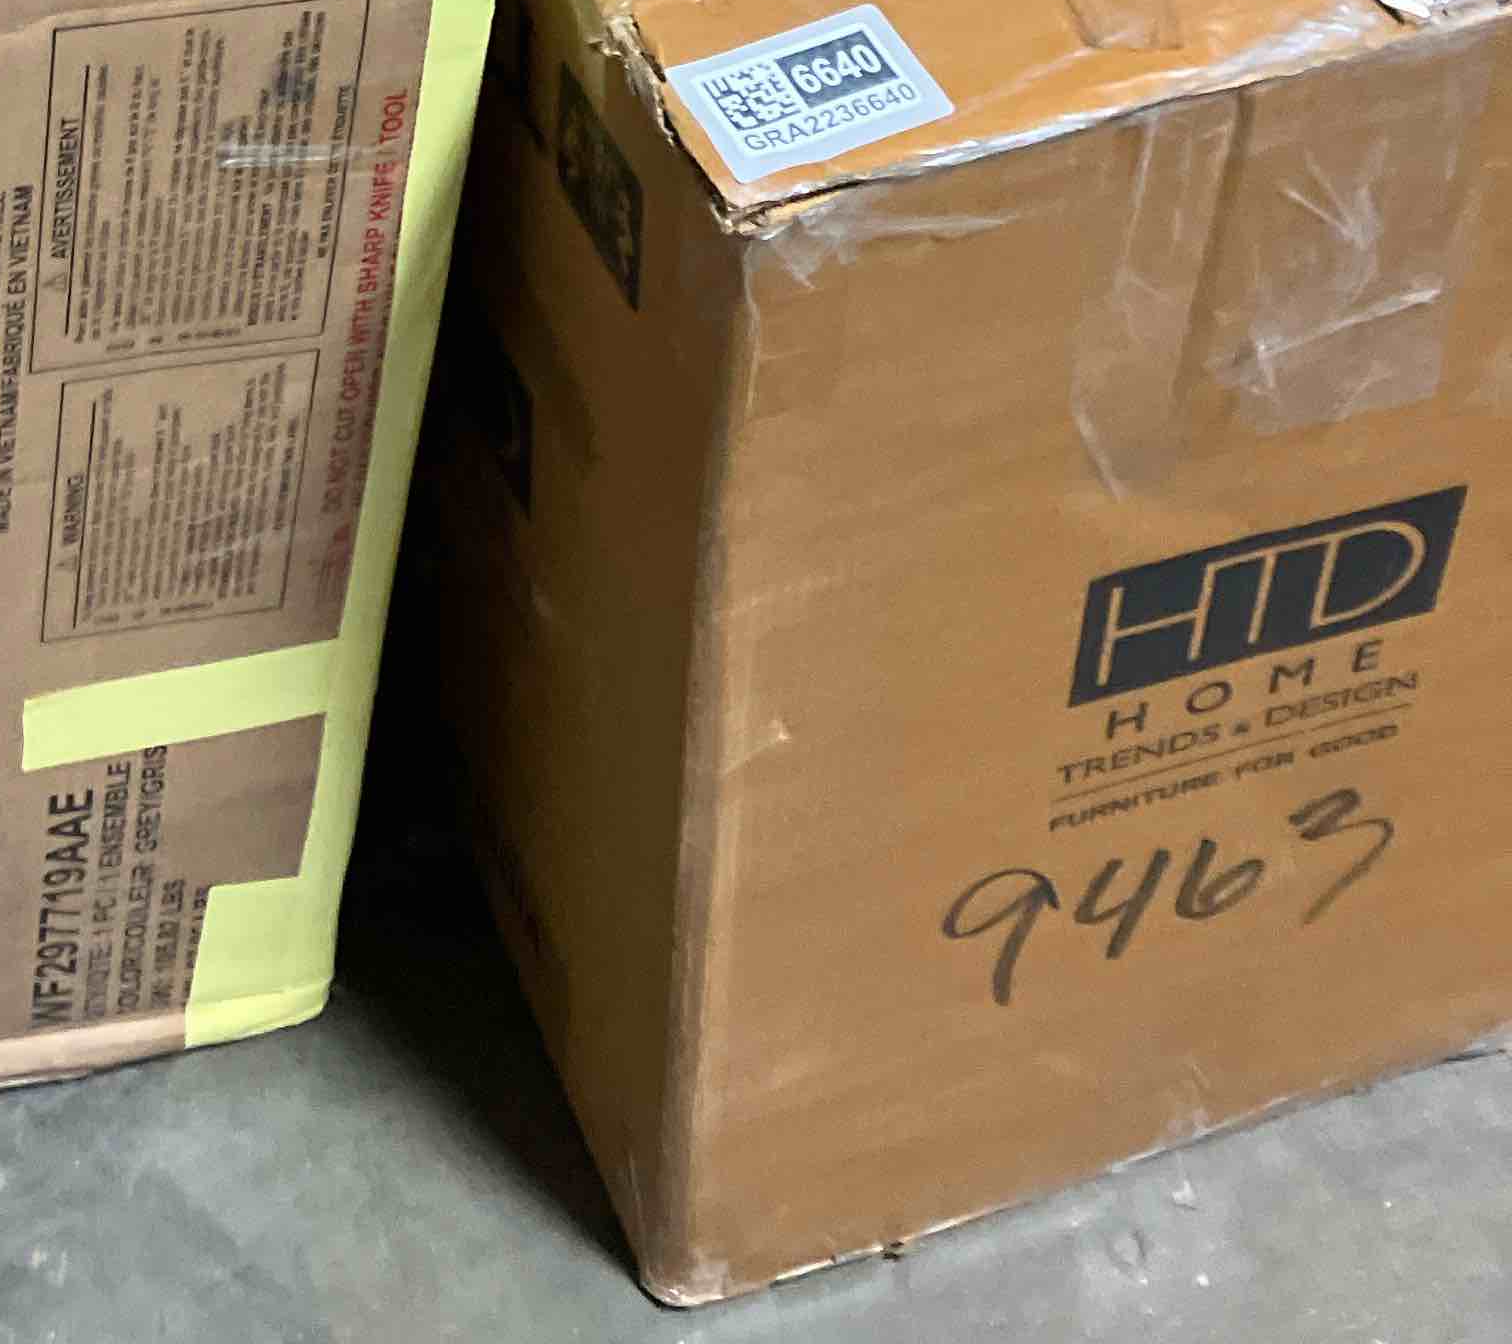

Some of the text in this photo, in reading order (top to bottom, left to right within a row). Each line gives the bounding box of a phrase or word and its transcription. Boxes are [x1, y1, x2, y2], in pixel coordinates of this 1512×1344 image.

[789, 42, 884, 95] 6640
[379, 88, 408, 146] TOOL
[743, 82, 917, 152] GRA2236640
[50, 117, 82, 260] AVERTISSEMENT
[368, 161, 397, 221] KNIFE
[9, 183, 35, 269] VIETNAM
[357, 226, 386, 295] SHARP
[7, 269, 28, 296] EN
[350, 298, 373, 345] WITH
[341, 349, 365, 401] OPEN
[62, 471, 86, 547] WARNING
[1104, 639, 1383, 741] HOME
[1056, 722, 1223, 785] TRENDS
[1263, 670, 1420, 729] DESIGN
[99, 759, 132, 869] ENSEMBLE
[1047, 723, 1400, 833] FURNITURE FOR GOOD
[940, 787, 1395, 1007] 9463
